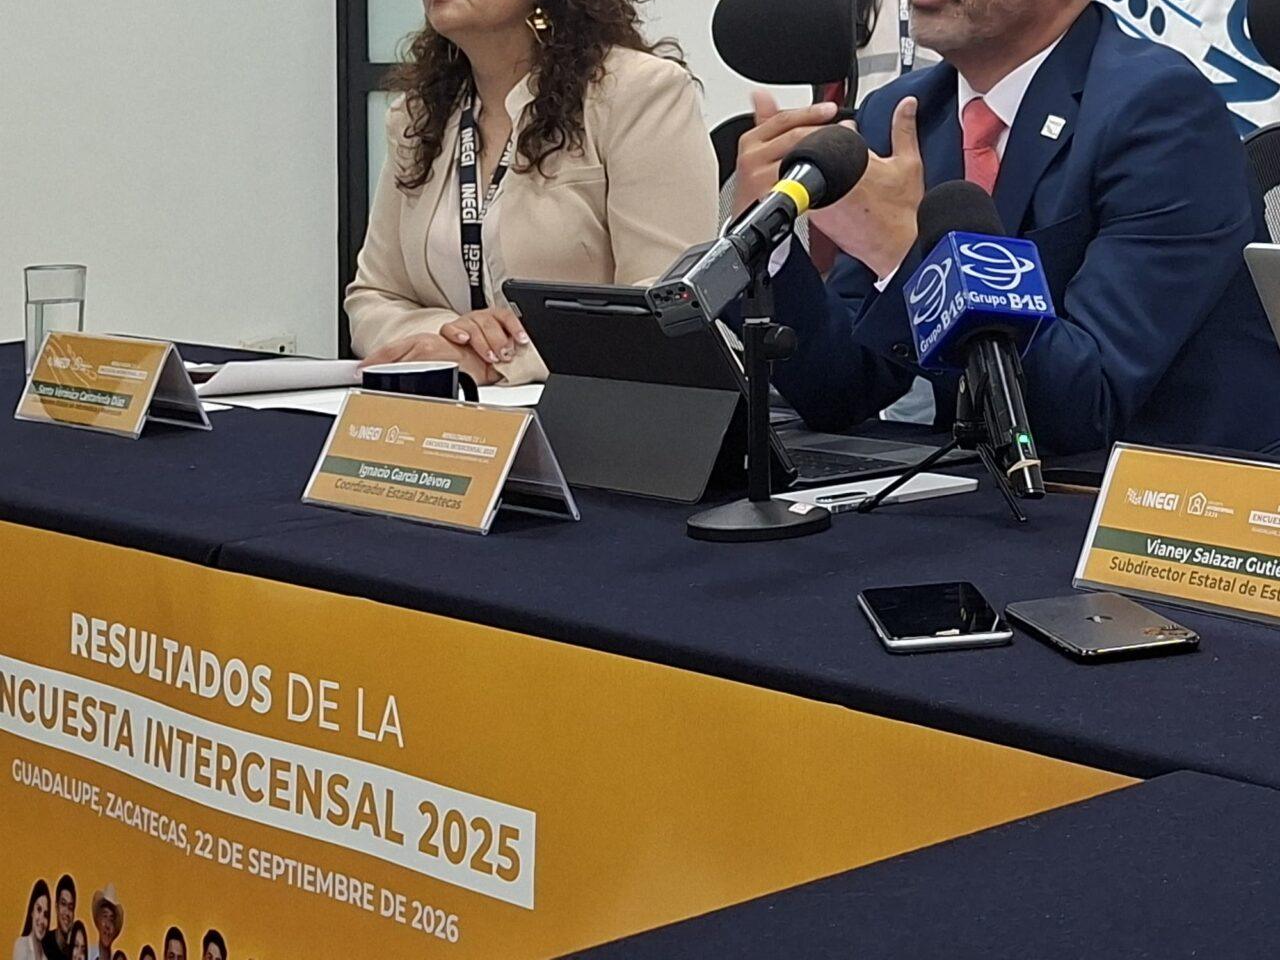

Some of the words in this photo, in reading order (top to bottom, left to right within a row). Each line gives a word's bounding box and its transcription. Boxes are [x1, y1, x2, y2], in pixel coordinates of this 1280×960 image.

[461, 127, 475, 166] INEGI
[462, 183, 476, 224] INEGI
[469, 244, 480, 286] INEGI
[969, 291, 1007, 308] Grupo
[920, 324, 942, 353] Grupo
[334, 478, 384, 496] Coordinador
[386, 486, 417, 501] Estatal
[416, 491, 462, 510] Zacatecas
[359, 464, 391, 478] Ignacio
[390, 468, 419, 483] García
[419, 472, 452, 489] Dévora
[1141, 490, 1180, 511] INEGI
[1146, 538, 1192, 564] Vianey
[1192, 547, 1243, 570] Salazar
[1109, 556, 1186, 584] Subdirector
[1188, 571, 1237, 593] Estatal
[1238, 579, 1257, 597] de
[71, 612, 272, 715] RESULTADOS
[287, 672, 340, 732] DE
[357, 687, 404, 748] LA
[144, 717, 404, 846] INTERCENSAL
[418, 800, 521, 884] 2025
[12, 758, 103, 817] GUADALUPE,
[105, 792, 191, 856] ZACATECAS,
[194, 830, 214, 860] 22
[218, 837, 244, 870] DE
[248, 847, 375, 912] SEPTIEMBRE
[380, 888, 407, 924] DE
[411, 901, 460, 943] 2026
